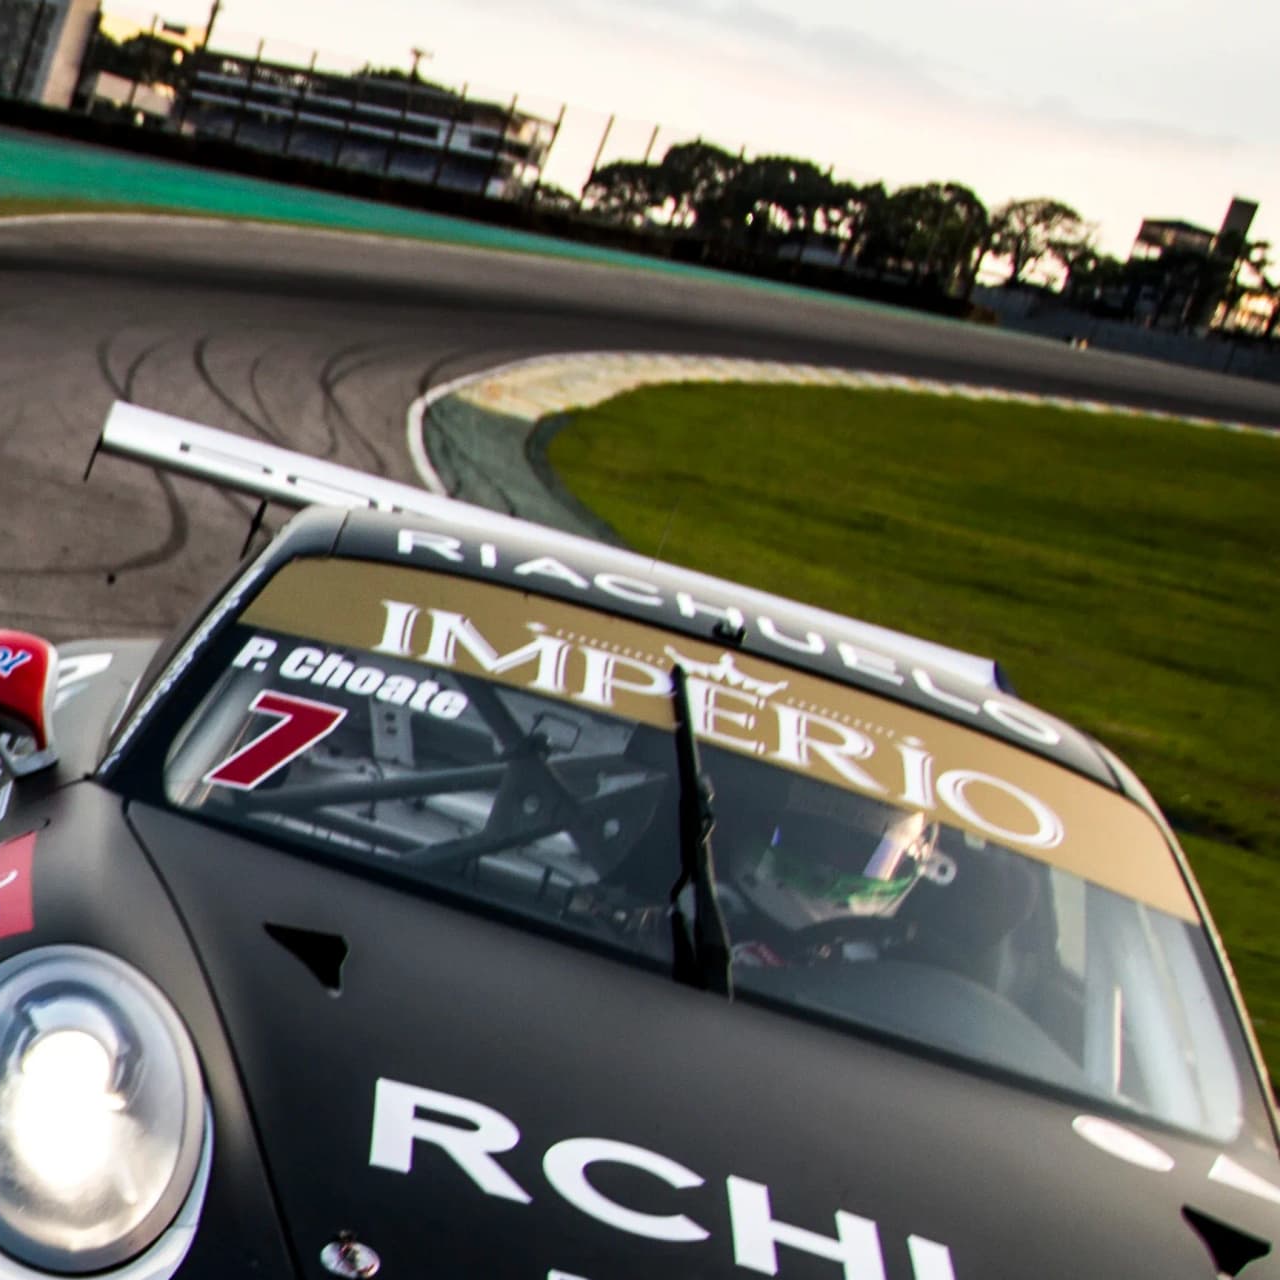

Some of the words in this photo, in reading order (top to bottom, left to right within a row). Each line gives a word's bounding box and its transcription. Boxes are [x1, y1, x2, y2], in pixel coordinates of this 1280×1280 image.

[232, 636, 278, 673] P.
[279, 648, 469, 721] Choate
[396, 529, 1061, 747] RIACHUELO
[202, 689, 348, 792] 7
